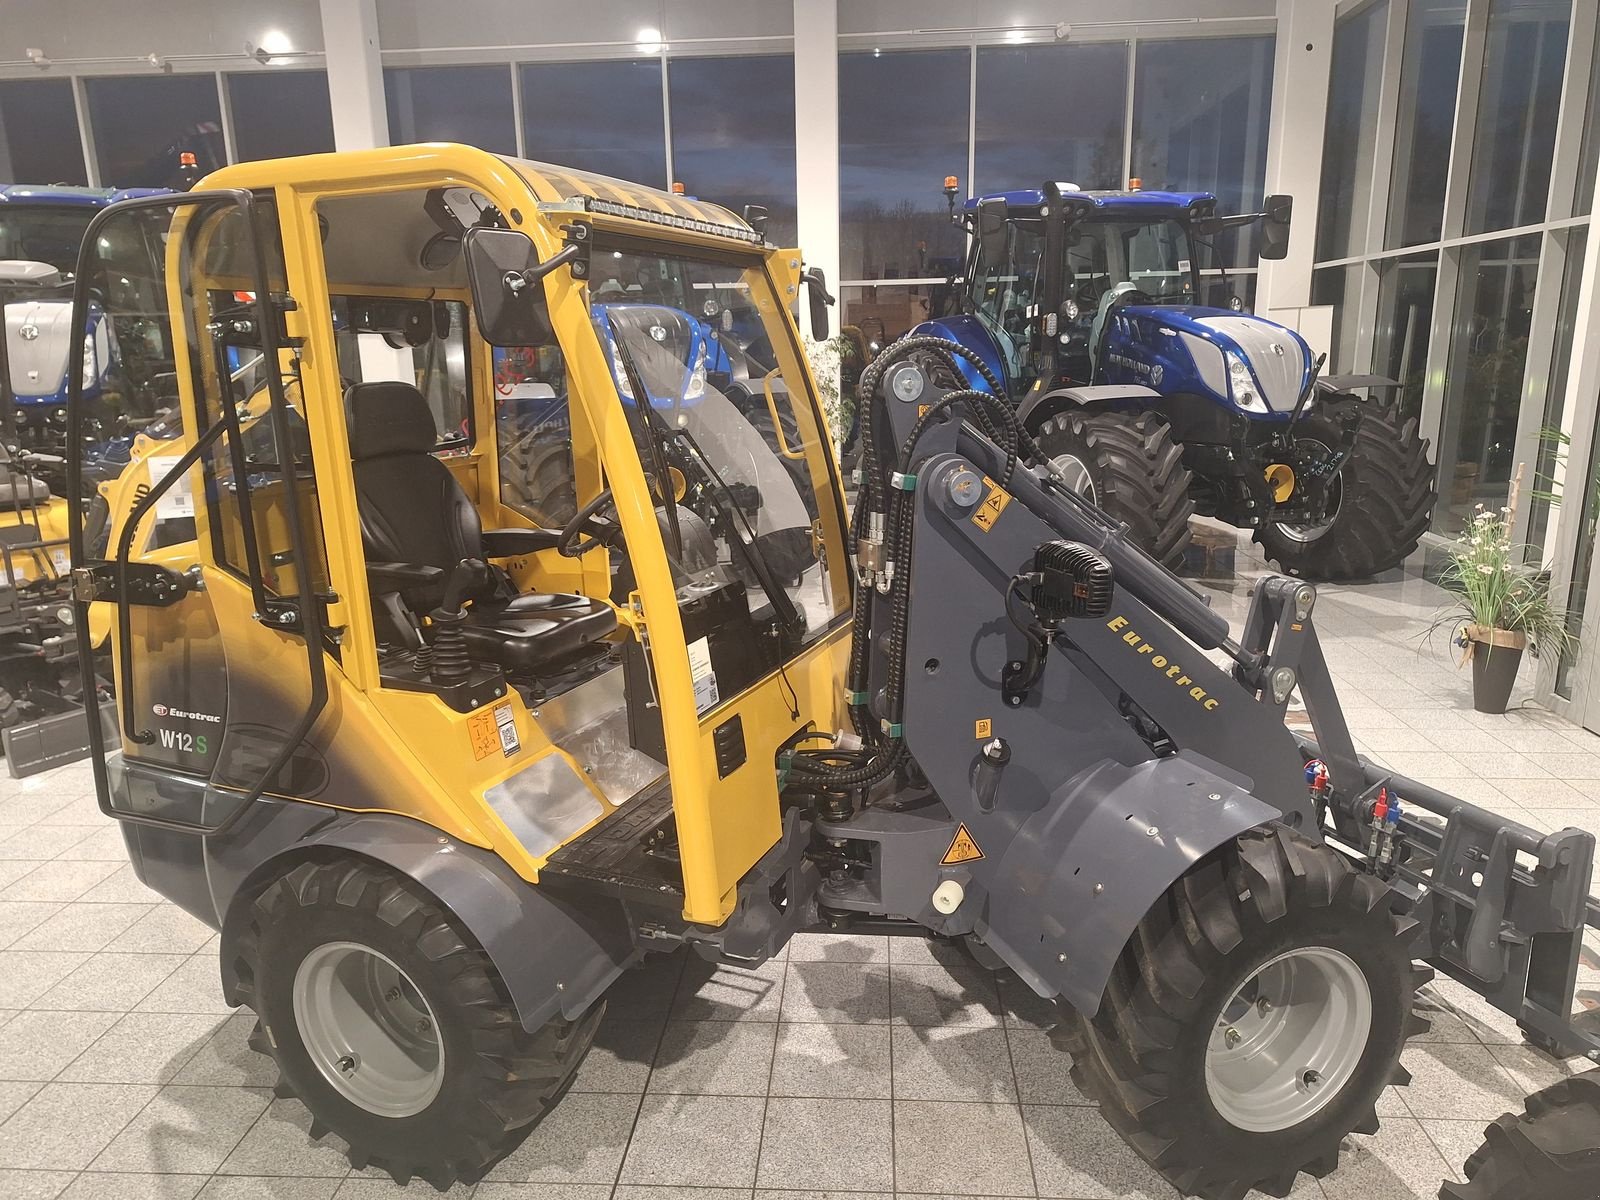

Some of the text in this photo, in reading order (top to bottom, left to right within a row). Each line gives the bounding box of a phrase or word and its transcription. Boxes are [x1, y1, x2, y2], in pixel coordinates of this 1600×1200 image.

[1106, 615, 1219, 710] Eurotrac
[169, 707, 221, 723] Eurotrac
[159, 728, 208, 754] W12 S
